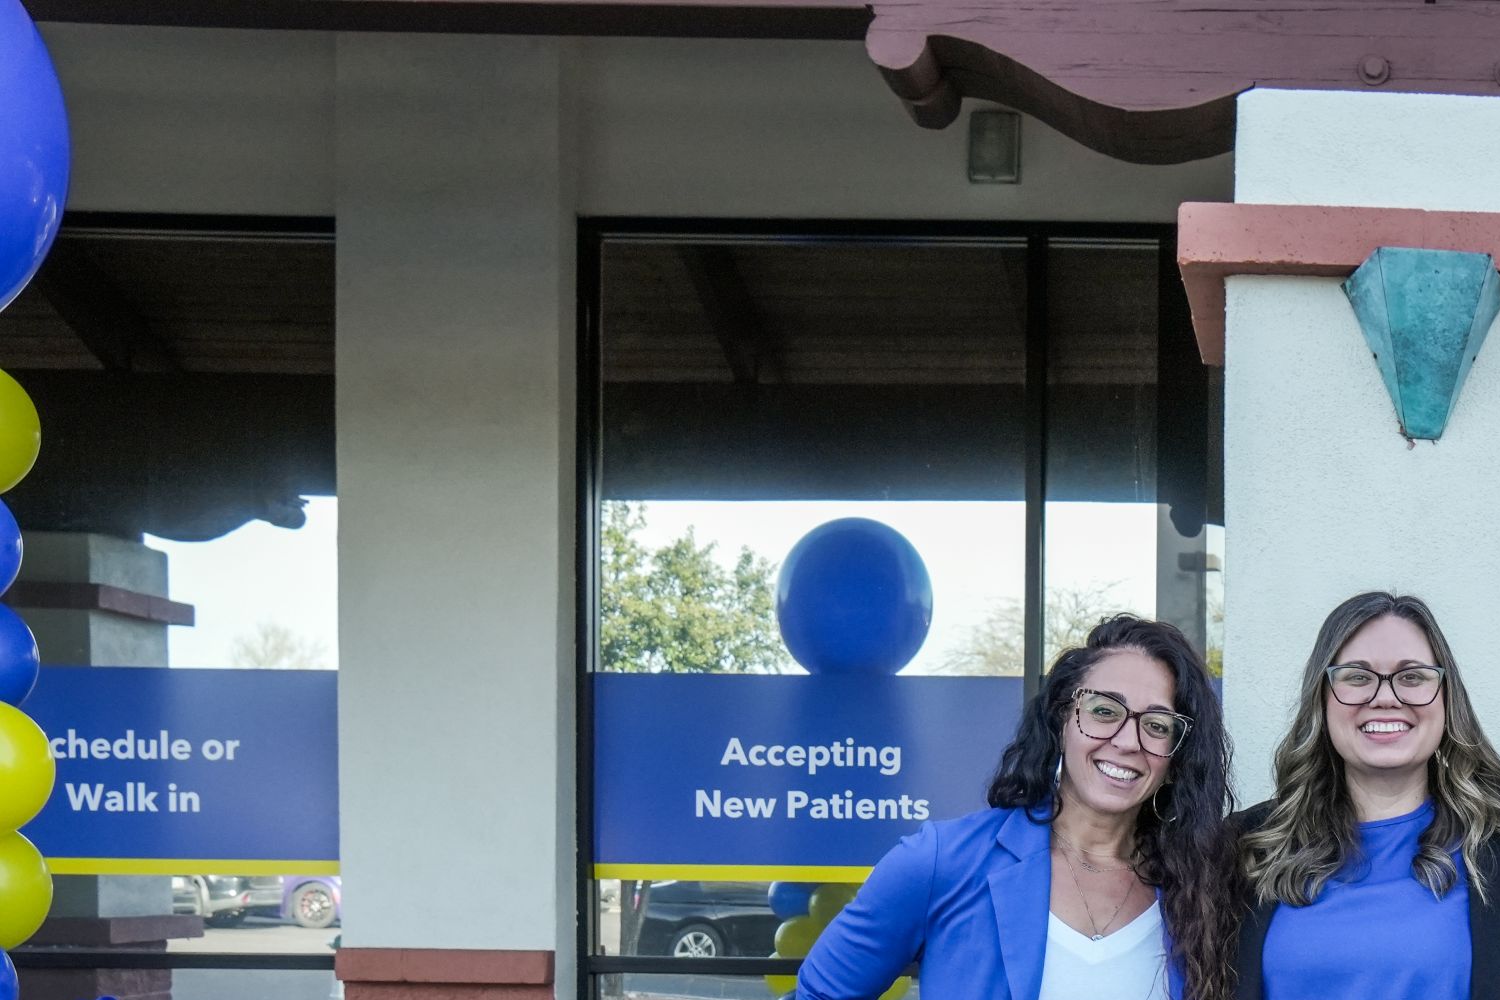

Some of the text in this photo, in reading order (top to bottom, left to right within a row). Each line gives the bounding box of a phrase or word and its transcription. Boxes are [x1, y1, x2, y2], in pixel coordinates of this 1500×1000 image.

[50, 728, 240, 761] chedule or
[720, 737, 902, 776] Accepting
[65, 782, 200, 813] Walk in
[695, 789, 930, 820] New Patients
